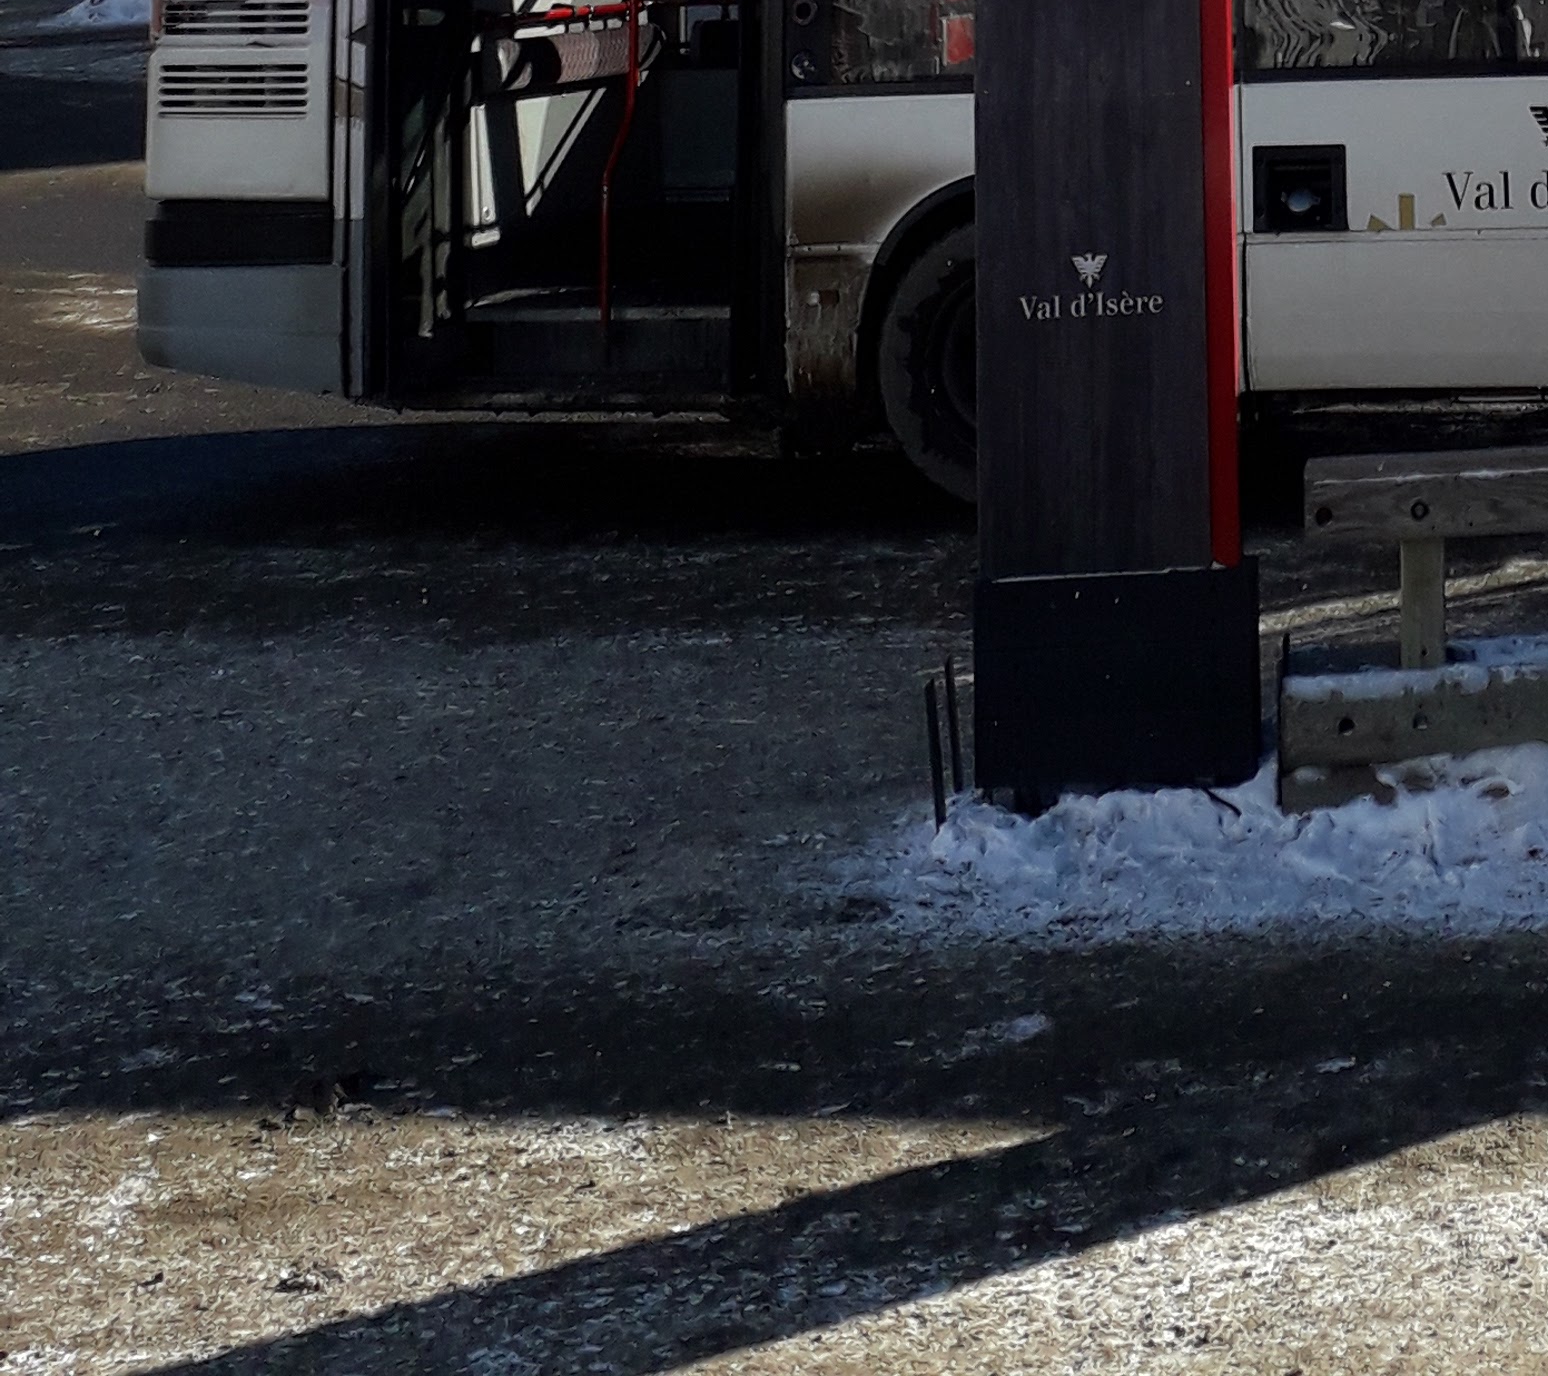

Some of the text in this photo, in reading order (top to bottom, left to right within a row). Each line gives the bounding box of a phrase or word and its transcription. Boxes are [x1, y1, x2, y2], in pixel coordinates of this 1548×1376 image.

[1441, 169, 1512, 211] Val
[1020, 290, 1164, 320] Val d'Isère
